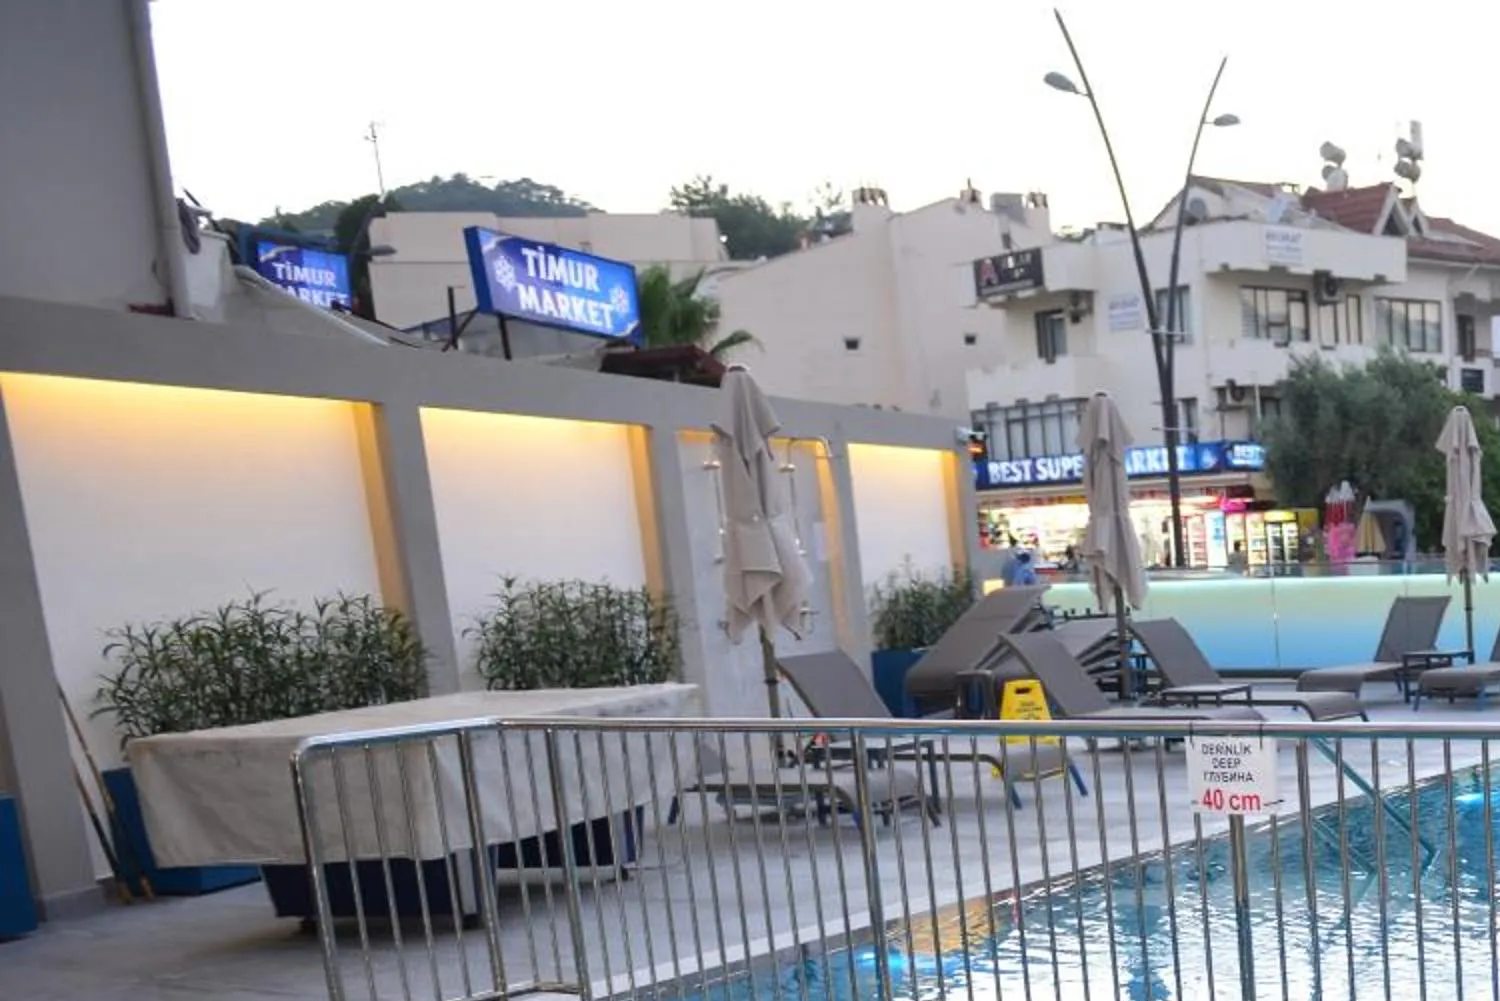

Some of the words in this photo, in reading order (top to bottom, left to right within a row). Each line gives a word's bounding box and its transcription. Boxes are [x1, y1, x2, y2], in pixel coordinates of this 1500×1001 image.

[272, 261, 337, 288] TİMUR
[520, 245, 600, 292] TİMUR
[285, 285, 349, 308] ARKET
[514, 282, 615, 330] MARKET
[988, 459, 1032, 484] BEST
[1035, 455, 1084, 481] SUPE
[1212, 758, 1241, 769] DEEP
[1203, 788, 1224, 811] 40
[1229, 794, 1261, 811] cm
